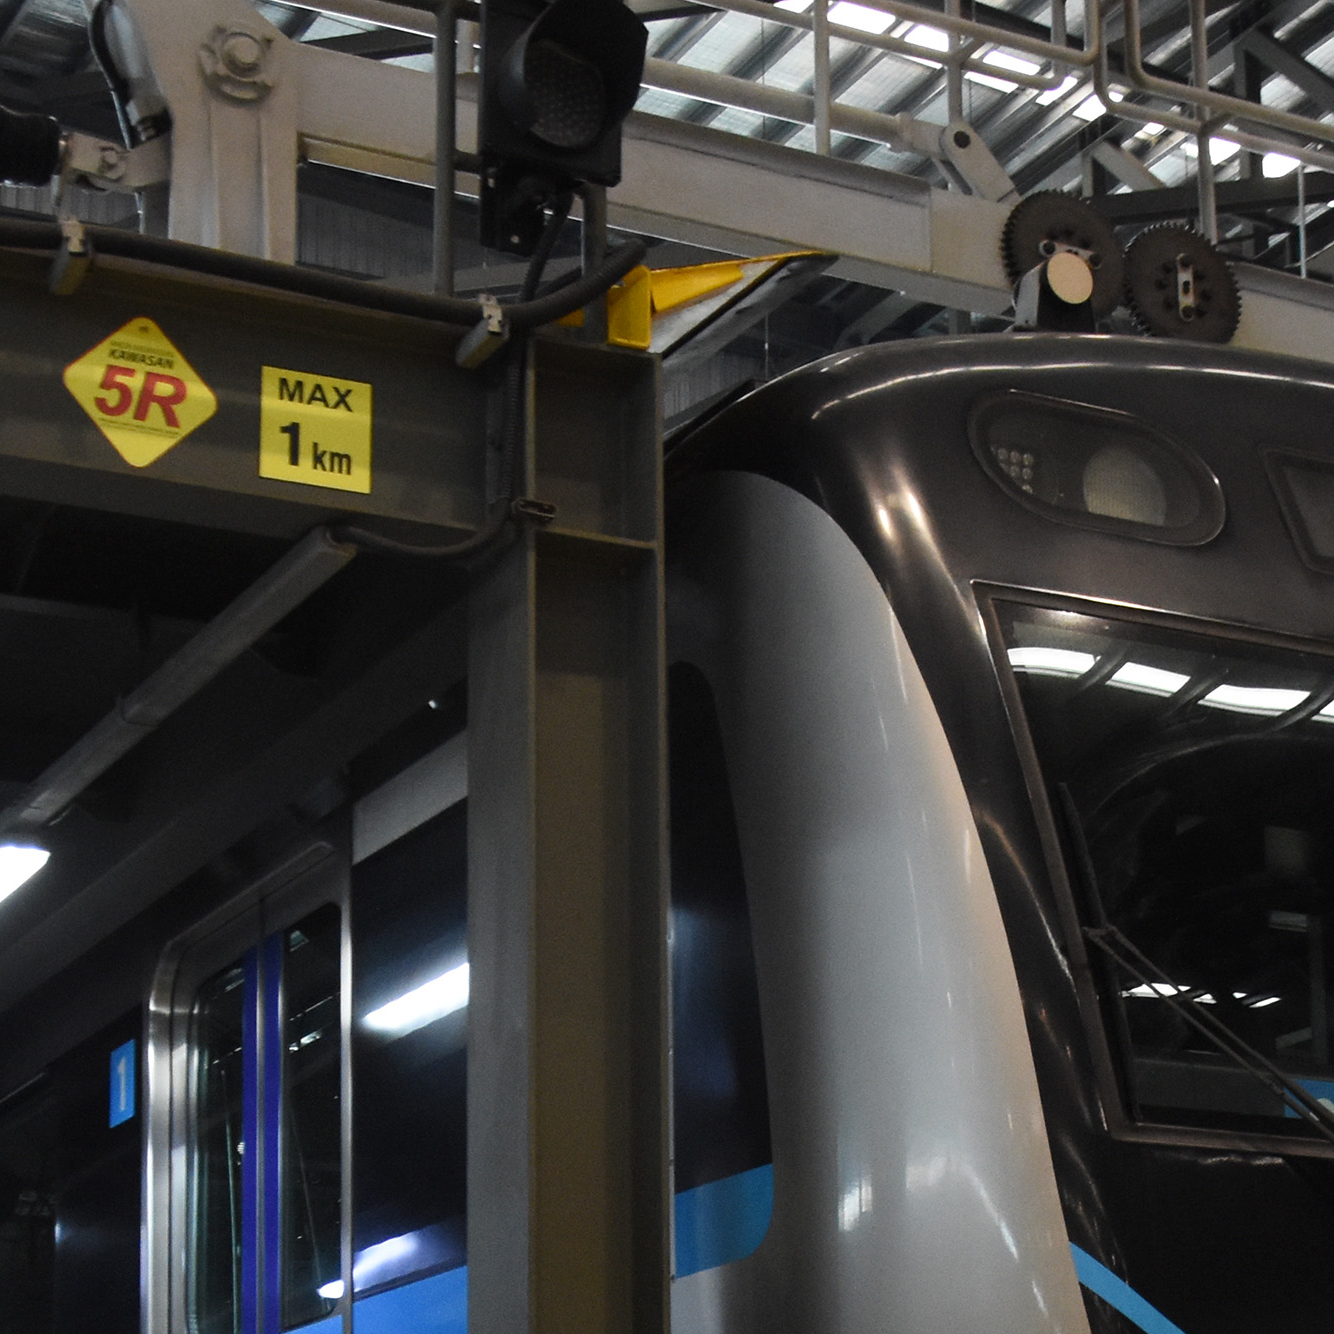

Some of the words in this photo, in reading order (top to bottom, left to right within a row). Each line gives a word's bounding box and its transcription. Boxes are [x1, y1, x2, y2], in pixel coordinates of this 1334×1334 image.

[108, 348, 174, 370] KAWASAN
[94, 364, 187, 428] 5R
[278, 377, 353, 413] MAX
[280, 422, 300, 467] 1
[312, 442, 352, 476] km
[117, 1056, 126, 1112] 1
